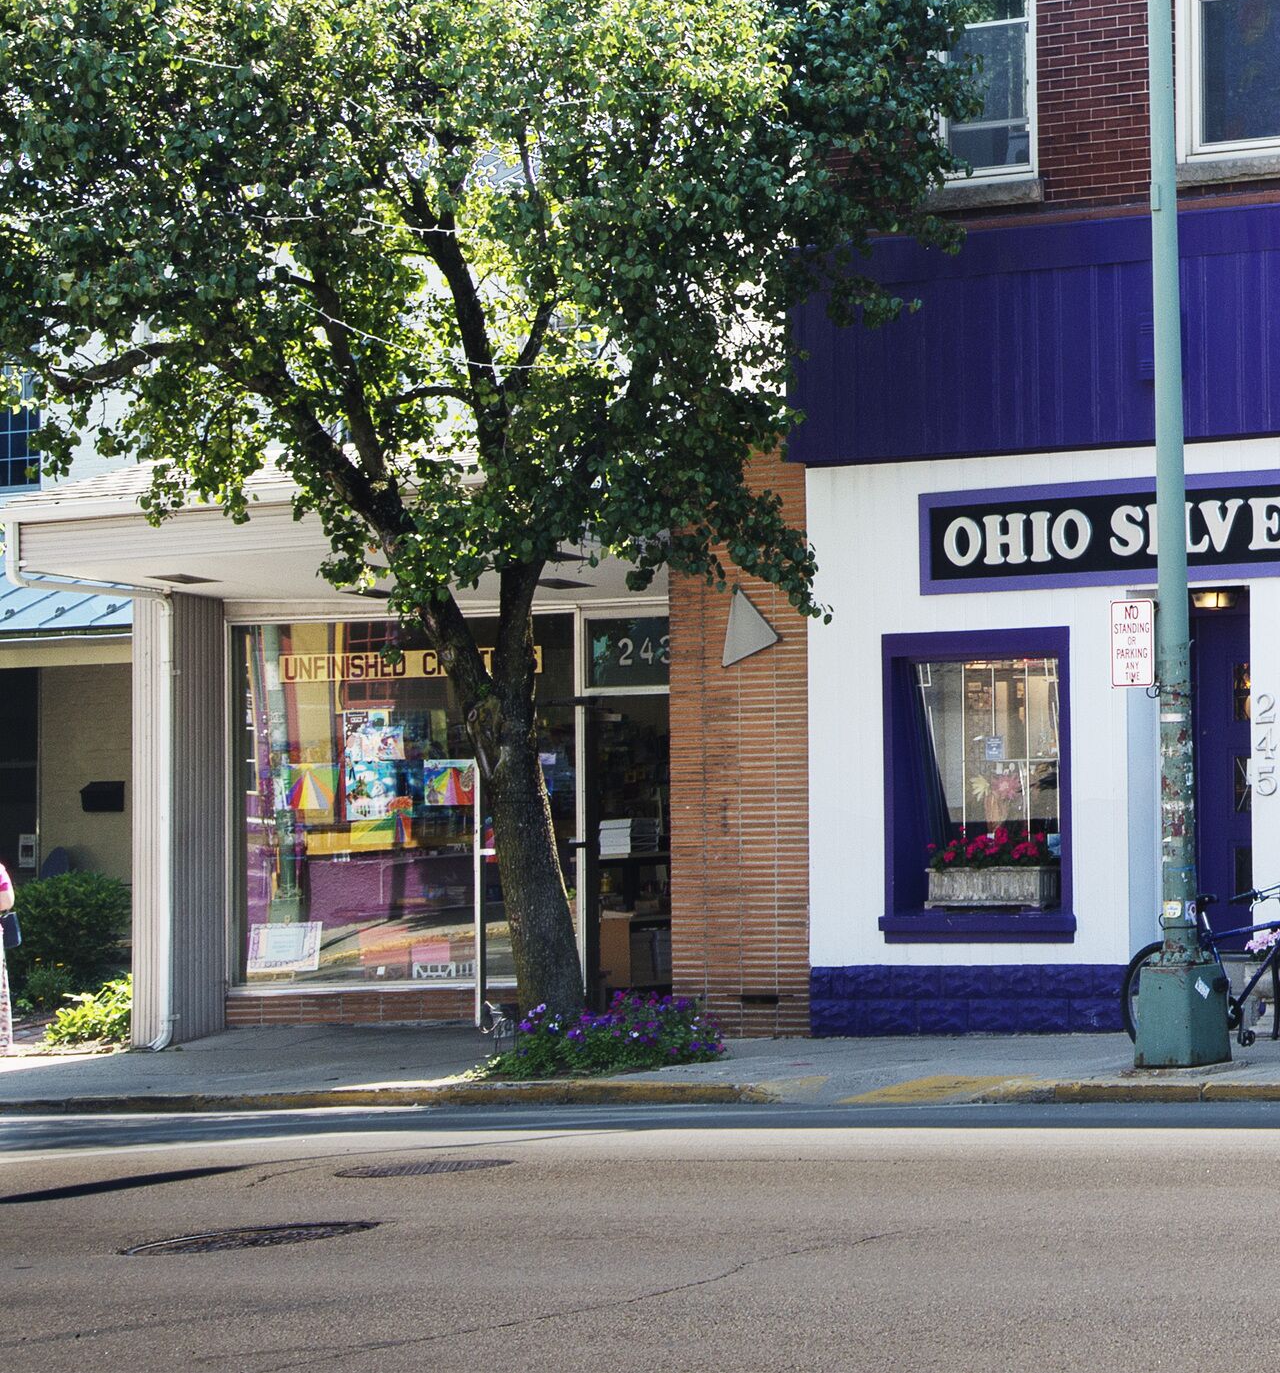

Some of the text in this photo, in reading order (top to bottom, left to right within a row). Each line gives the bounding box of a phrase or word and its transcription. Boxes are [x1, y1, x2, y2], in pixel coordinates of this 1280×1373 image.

[943, 508, 1093, 567] OHIO
[1124, 605, 1139, 620] NO
[1113, 622, 1150, 634] STANDING
[1127, 636, 1137, 646] OR
[1116, 647, 1148, 659] PARKING
[284, 653, 406, 680] UNFINISHED
[1125, 661, 1140, 670] ANY
[1125, 671, 1140, 681] TIME
[1255, 692, 1278, 797] 245
